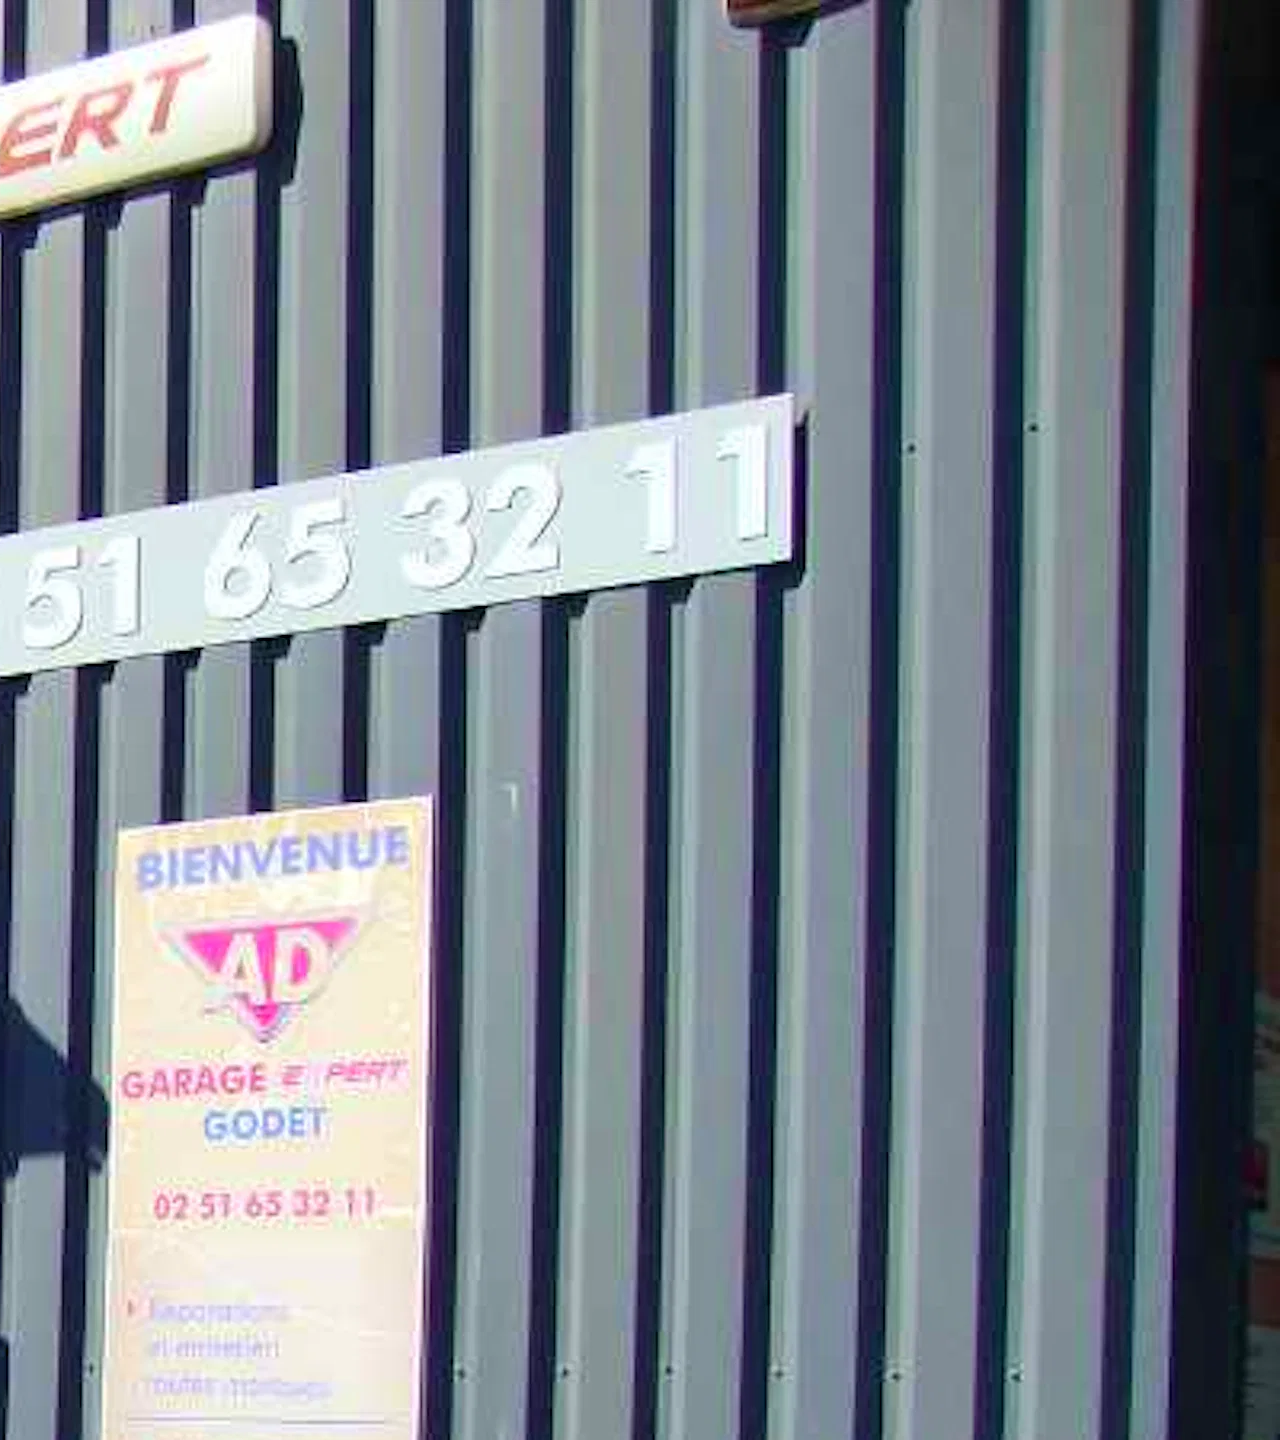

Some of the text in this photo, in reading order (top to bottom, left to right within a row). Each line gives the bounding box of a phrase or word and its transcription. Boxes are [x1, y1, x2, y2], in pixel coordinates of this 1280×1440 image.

[18, 534, 142, 652] 51
[202, 495, 353, 620] 65
[399, 460, 563, 590] 32
[616, 422, 770, 554] 11
[135, 826, 410, 892] BIENVENUE
[221, 924, 334, 1004] AD
[121, 1062, 269, 1100] GARAGE
[204, 1107, 329, 1142] GODET
[154, 1188, 376, 1221] 02 51 65 32 11
